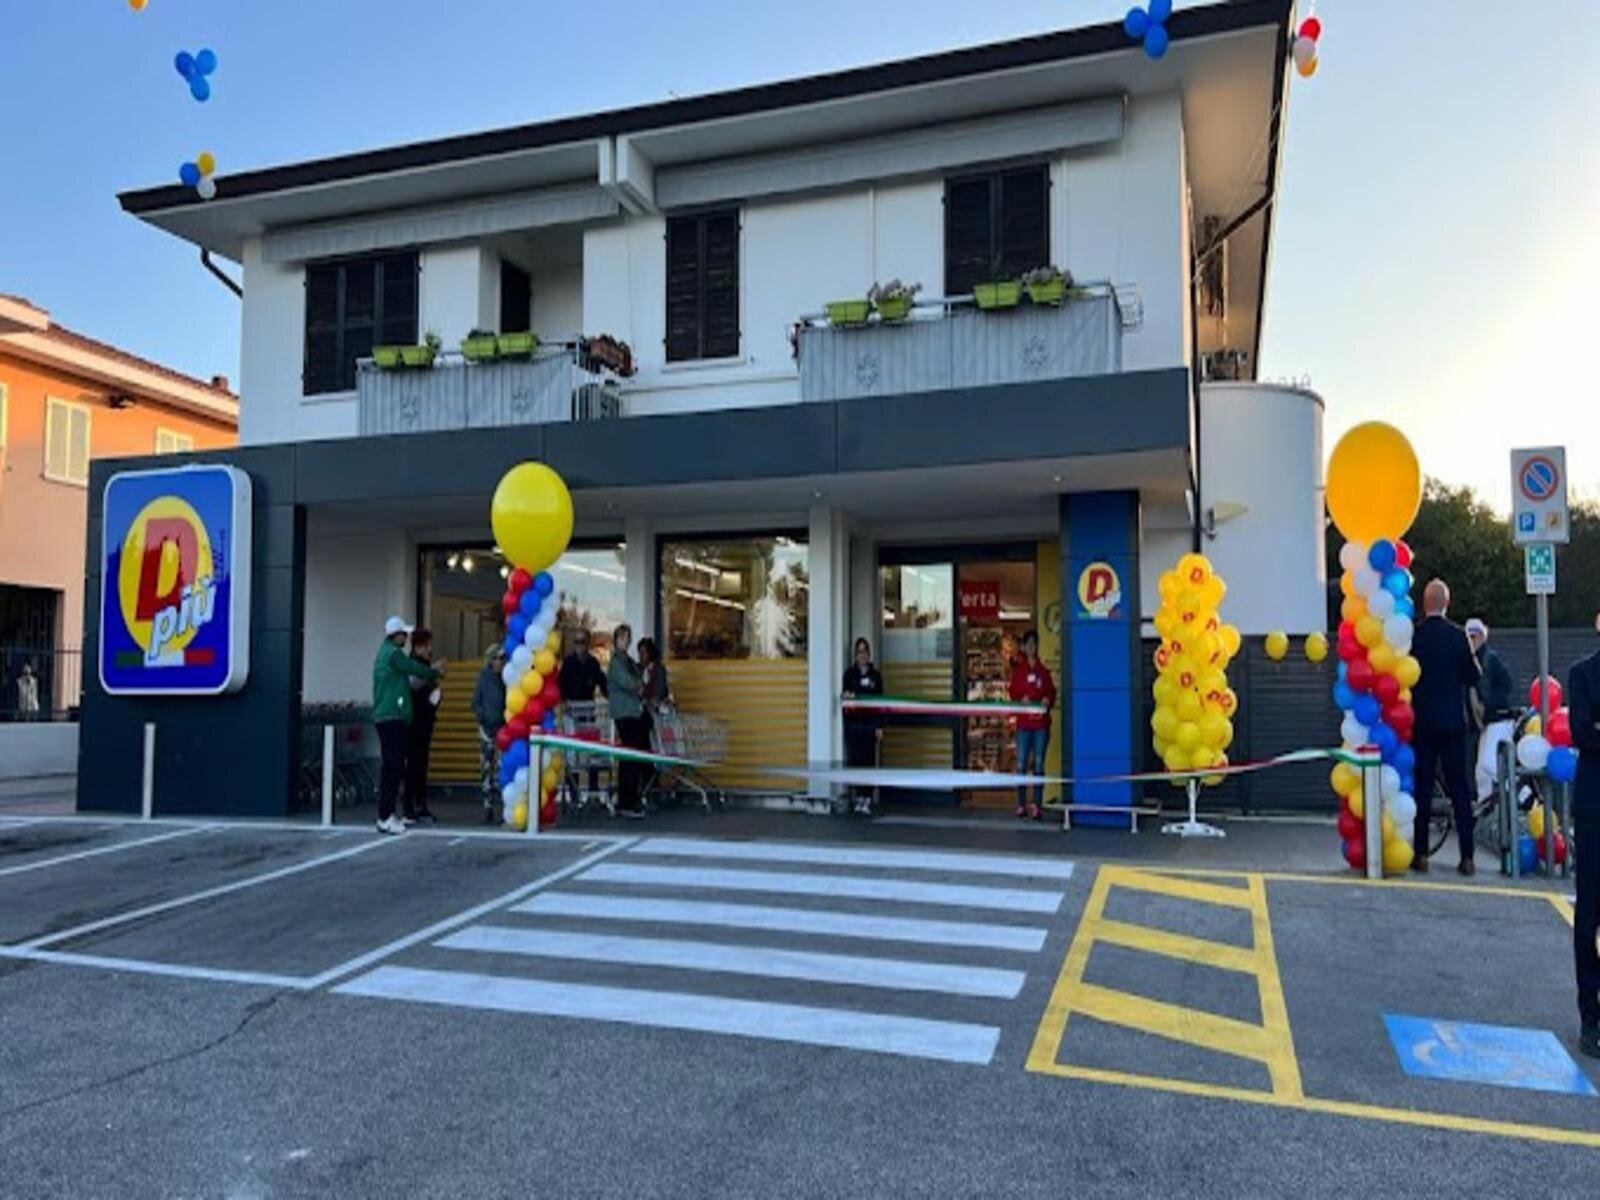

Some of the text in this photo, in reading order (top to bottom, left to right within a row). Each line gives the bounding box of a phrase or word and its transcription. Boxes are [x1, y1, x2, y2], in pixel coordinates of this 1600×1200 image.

[135, 517, 199, 622] D
[959, 590, 996, 607] erta
[1086, 568, 1114, 604] D
[147, 575, 217, 661] più
